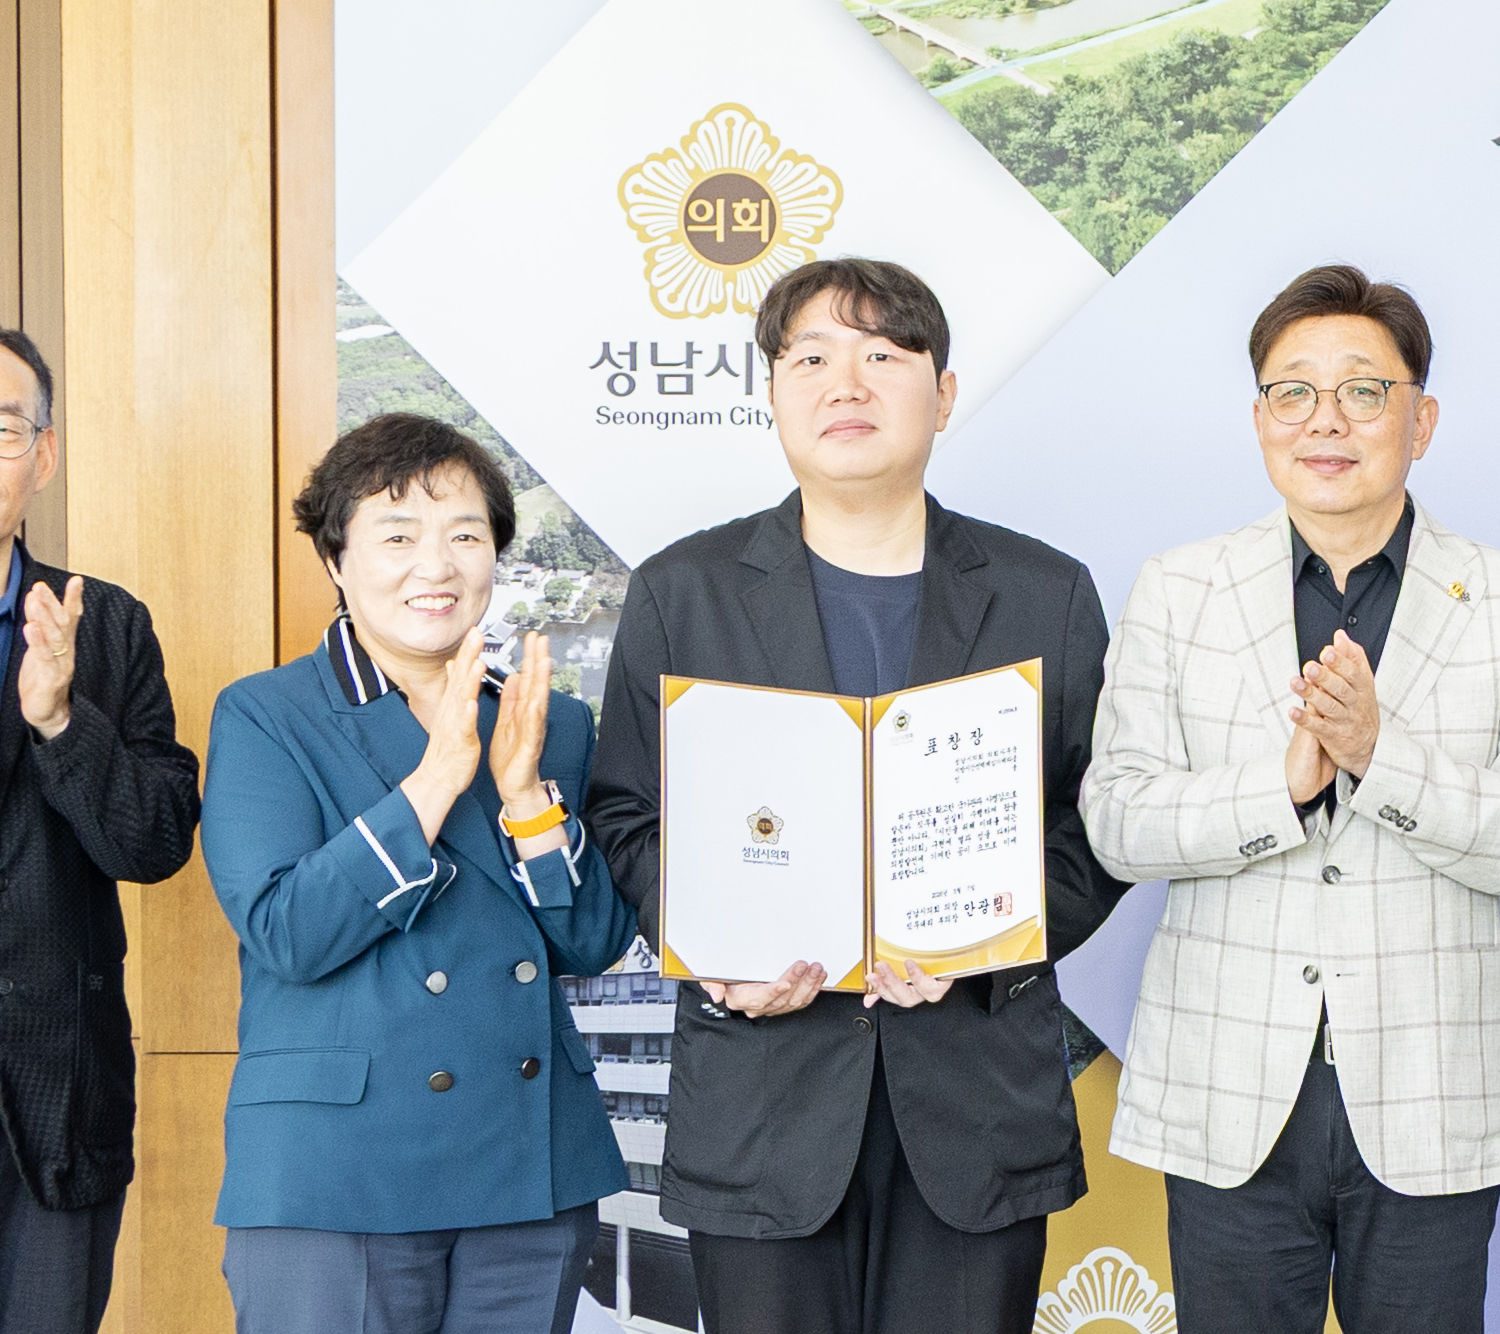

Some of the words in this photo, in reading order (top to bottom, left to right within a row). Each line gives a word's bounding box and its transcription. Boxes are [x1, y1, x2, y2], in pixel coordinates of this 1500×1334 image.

[687, 198, 770, 243] 의회
[589, 340, 754, 397] 성남시
[595, 405, 722, 431] Seongnam
[729, 405, 774, 430] City
[742, 847, 790, 862] 성남시의회
